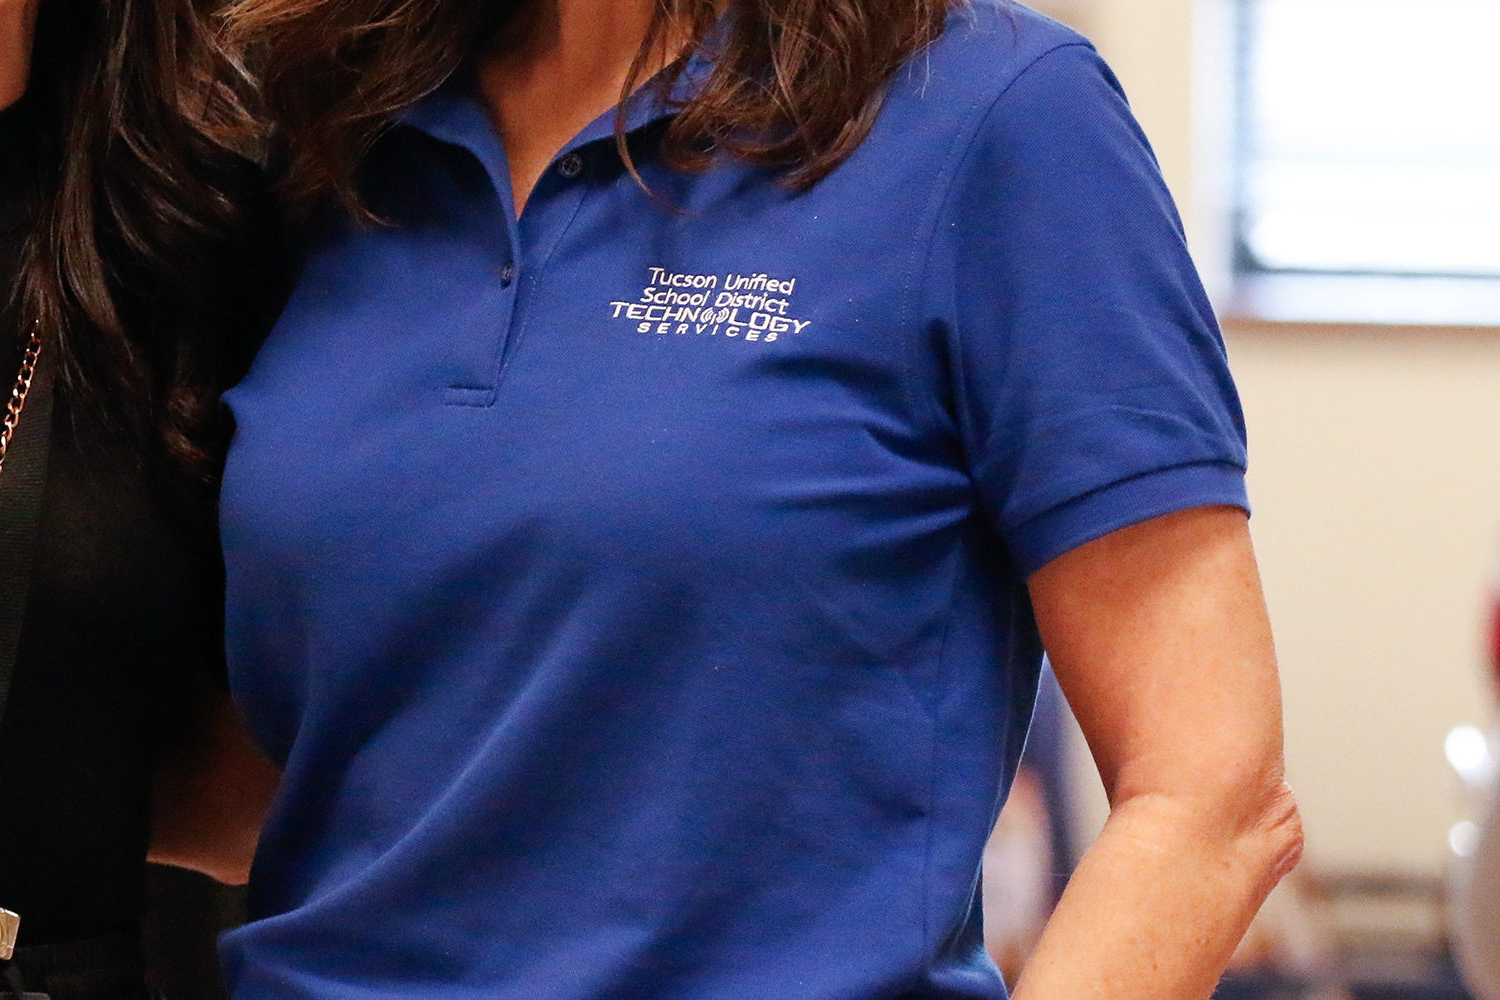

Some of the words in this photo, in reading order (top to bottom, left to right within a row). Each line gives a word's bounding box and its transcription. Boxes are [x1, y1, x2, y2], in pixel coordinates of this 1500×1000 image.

[649, 267, 717, 288] Tucson
[724, 273, 796, 295] Unified
[640, 287, 710, 306] School
[715, 291, 789, 315] District
[637, 322, 778, 342] SERVICES
